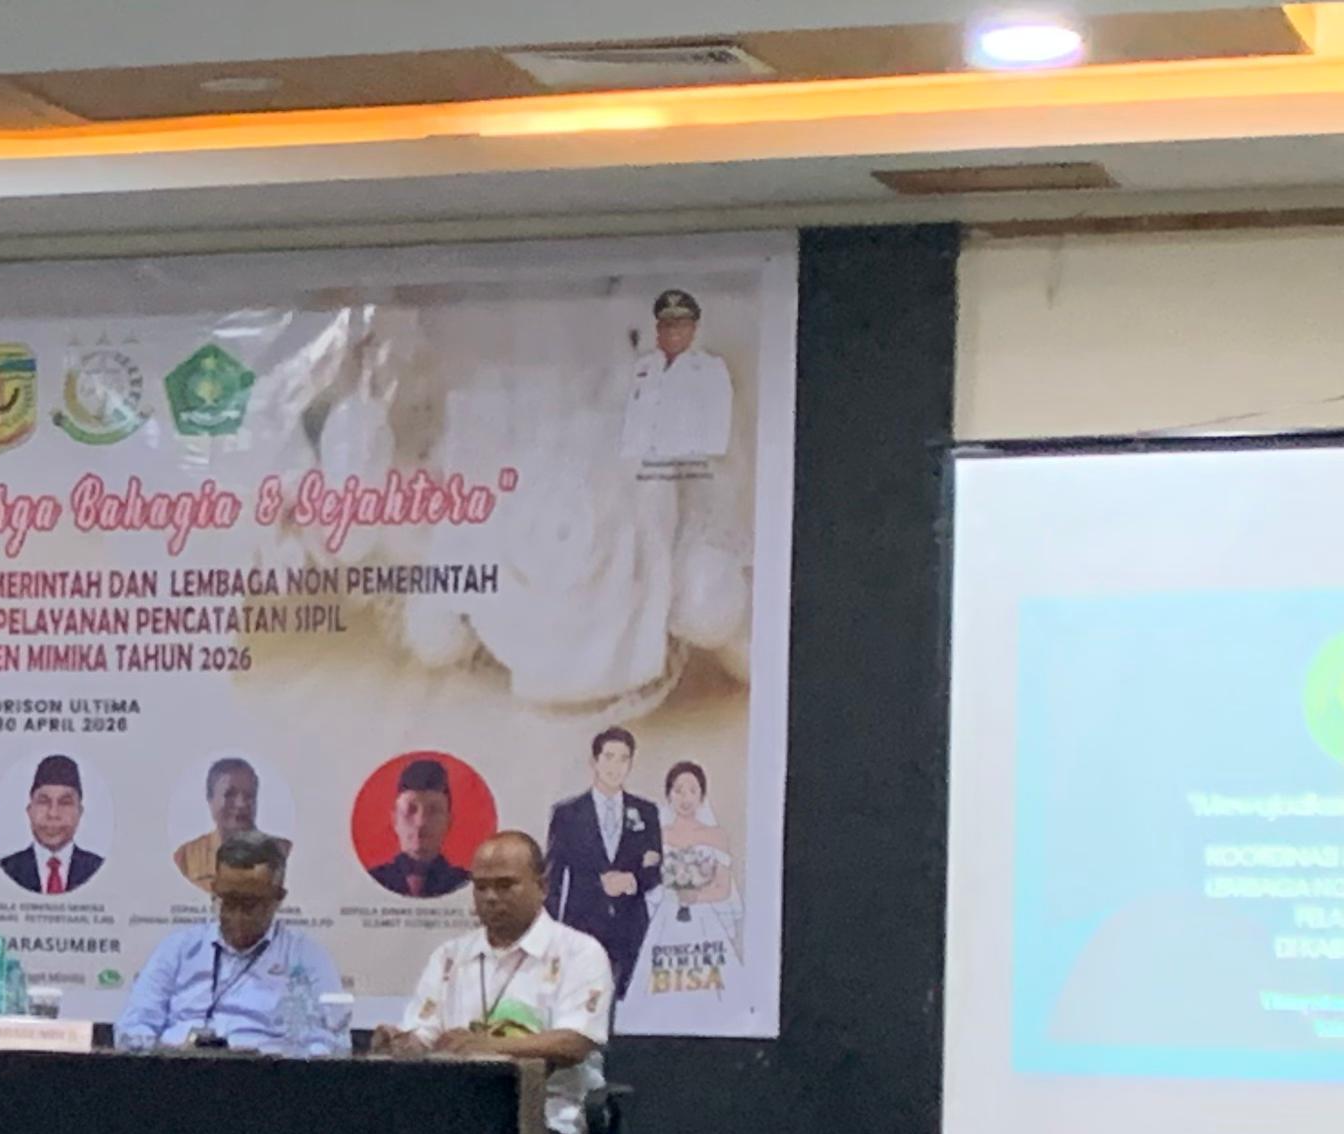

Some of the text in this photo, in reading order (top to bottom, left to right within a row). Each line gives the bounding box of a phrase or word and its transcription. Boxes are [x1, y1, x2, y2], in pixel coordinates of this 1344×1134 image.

[71, 472, 240, 556] Bahagia
[111, 569, 157, 598] DAN
[170, 568, 279, 597] LEMBAGA
[286, 567, 339, 595] NON
[346, 564, 499, 595] PEMERINTAH
[136, 606, 287, 635] PENCATATAN
[295, 605, 347, 633] SIPIL
[27, 645, 109, 672] MIMIKA
[116, 644, 197, 672] TAHUN
[199, 645, 252, 672] 2026
[70, 699, 141, 714] ULTIMA
[23, 717, 75, 732] APRIL
[81, 717, 127, 732] 2026
[2, 936, 121, 954] ARASUMBER
[651, 967, 725, 995] BISA
